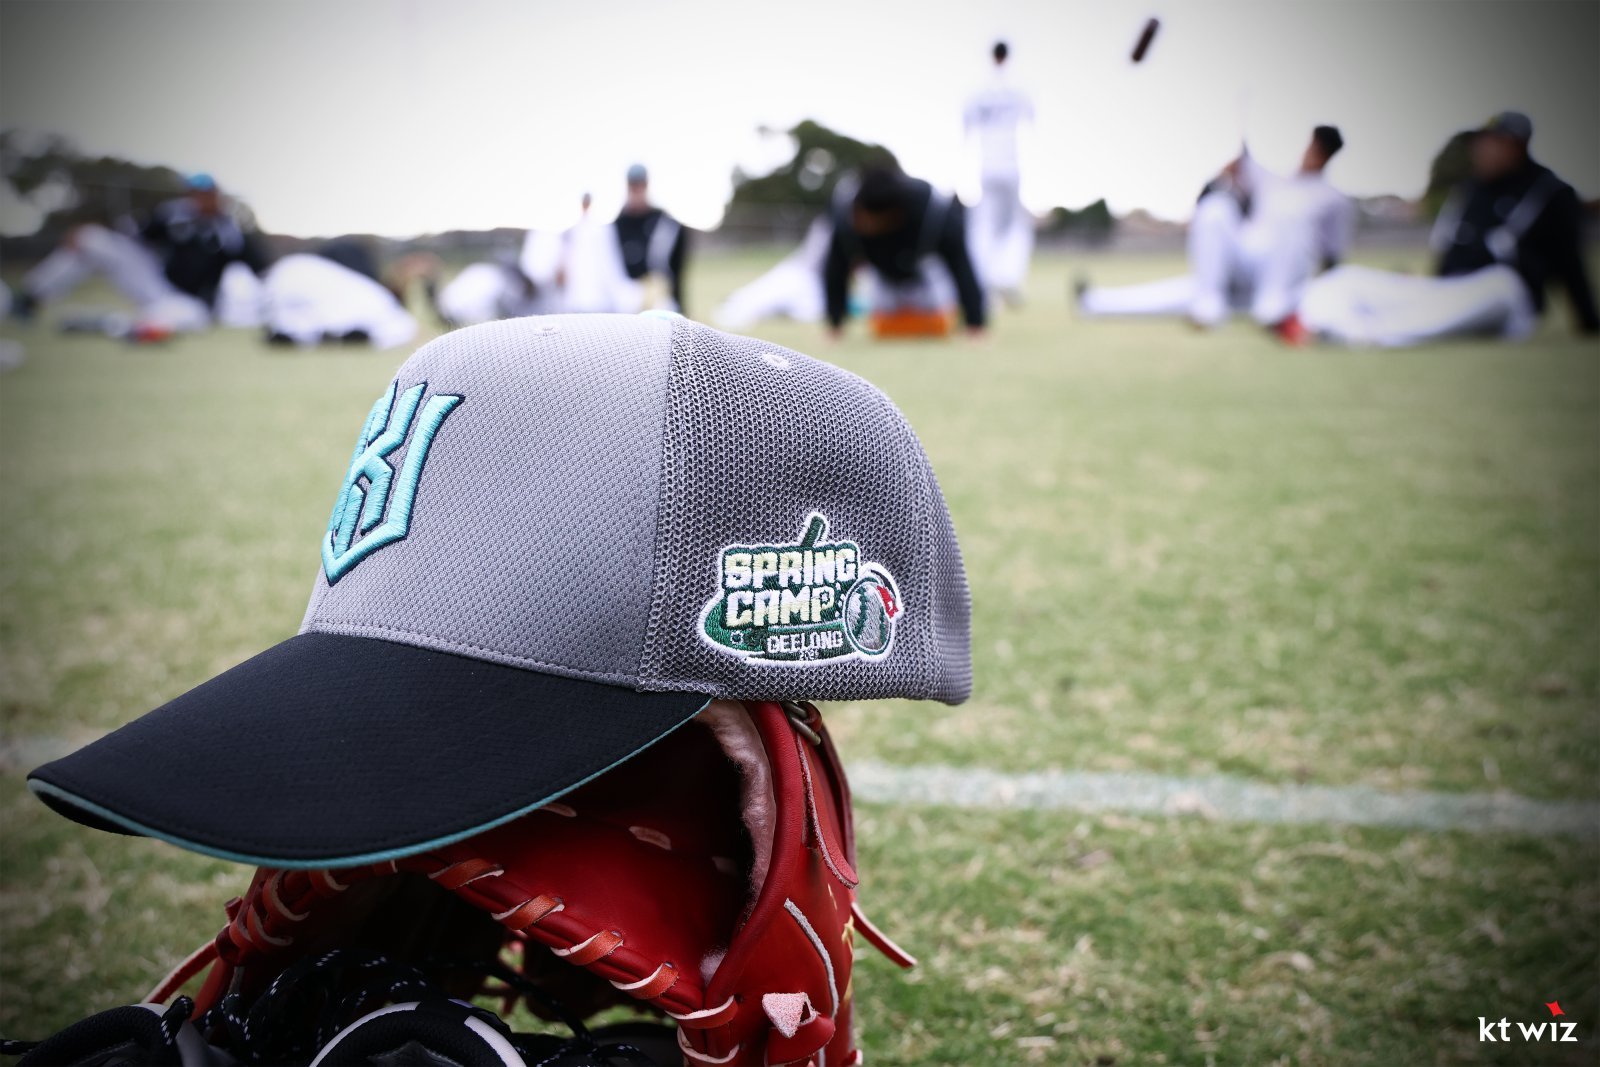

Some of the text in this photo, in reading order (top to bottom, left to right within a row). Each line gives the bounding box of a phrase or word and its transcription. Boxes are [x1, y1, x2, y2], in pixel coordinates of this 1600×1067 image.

[725, 548, 857, 588] SPRING
[726, 585, 835, 627] CAMP
[767, 630, 843, 653] GEELONG
